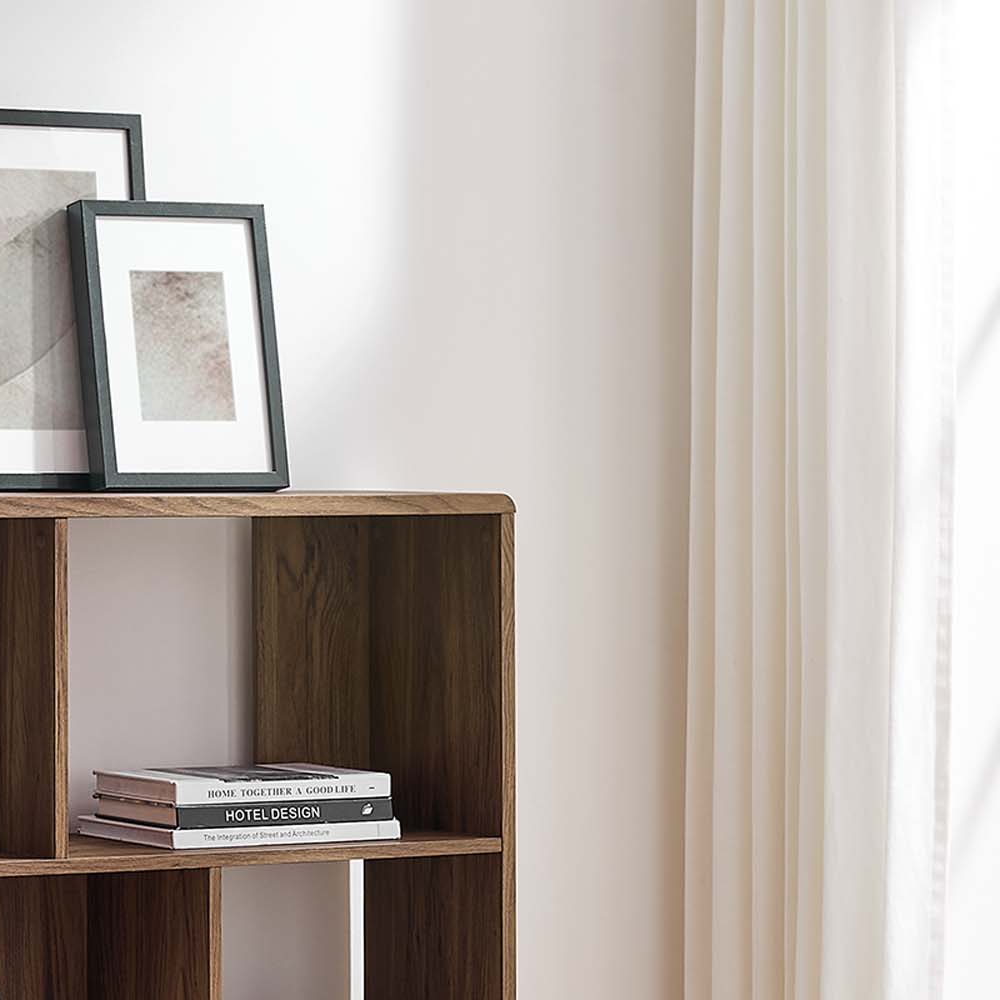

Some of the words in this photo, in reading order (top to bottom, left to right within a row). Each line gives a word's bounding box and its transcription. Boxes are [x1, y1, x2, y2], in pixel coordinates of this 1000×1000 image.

[207, 788, 237, 799] HOME
[239, 787, 293, 798] TOGETHER
[295, 787, 303, 796] A
[305, 785, 334, 795] GOOD
[335, 784, 357, 794] LIFE
[225, 807, 269, 822] HOTEL
[271, 806, 321, 821] DESIGN
[203, 833, 216, 841] The
[217, 831, 252, 842] Integration
[252, 831, 259, 840] of
[259, 830, 278, 840] Street
[279, 830, 291, 838] and
[292, 828, 330, 839] Architecture
